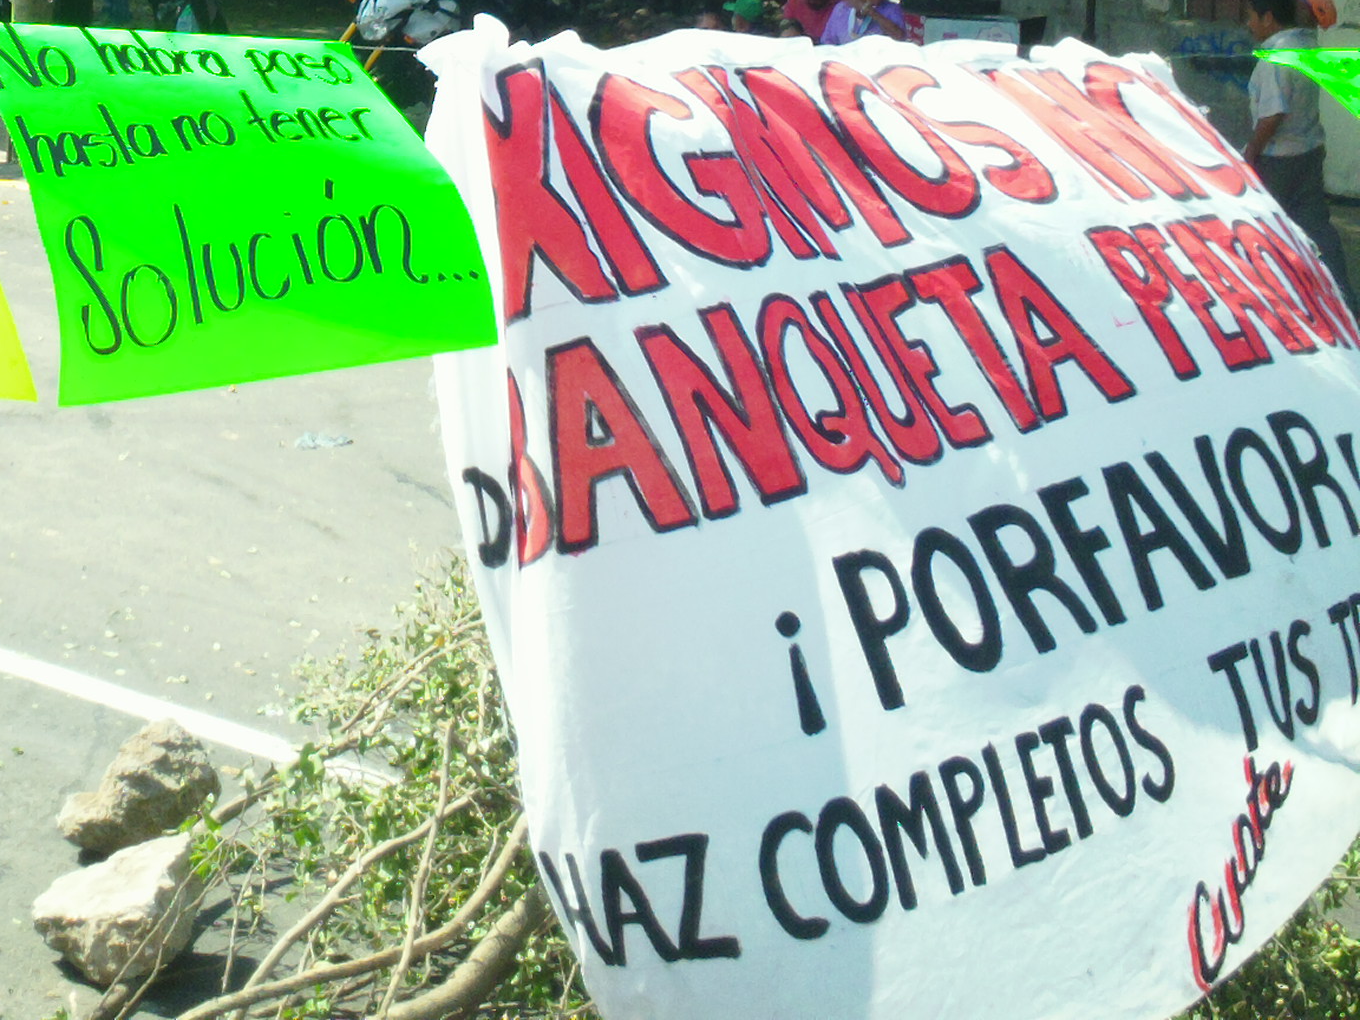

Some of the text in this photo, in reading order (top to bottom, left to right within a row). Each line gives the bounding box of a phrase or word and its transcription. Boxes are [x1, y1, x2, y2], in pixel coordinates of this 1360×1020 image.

[245, 49, 353, 92] paso
[16, 91, 371, 177] hasta no tener
[539, 832, 742, 967] HAZ
[759, 683, 1175, 940] COMPLETOS
[1207, 619, 1321, 752] TUS
